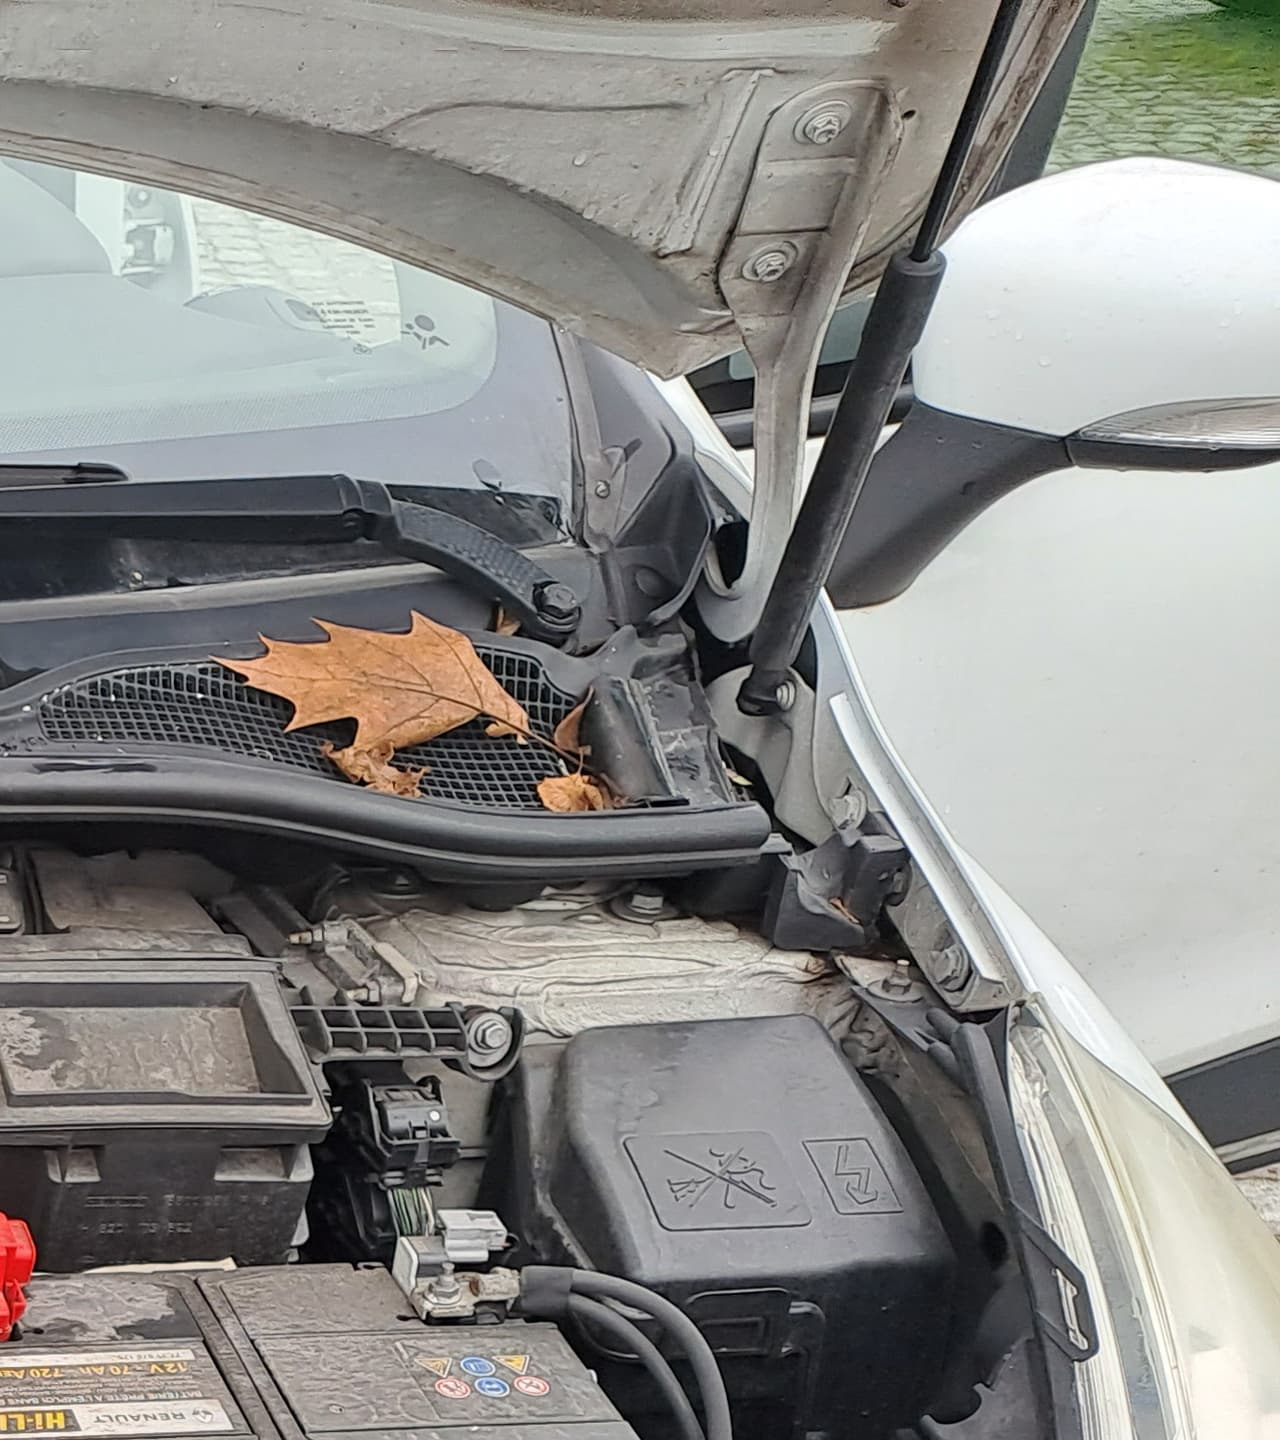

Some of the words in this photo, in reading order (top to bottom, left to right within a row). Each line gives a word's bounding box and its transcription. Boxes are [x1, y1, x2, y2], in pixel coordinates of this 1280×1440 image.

[30, 1368, 64, 1378] 720
[79, 1366, 104, 1375] Ah
[110, 1364, 130, 1375] 70
[93, 1411, 186, 1424] RENAULT
